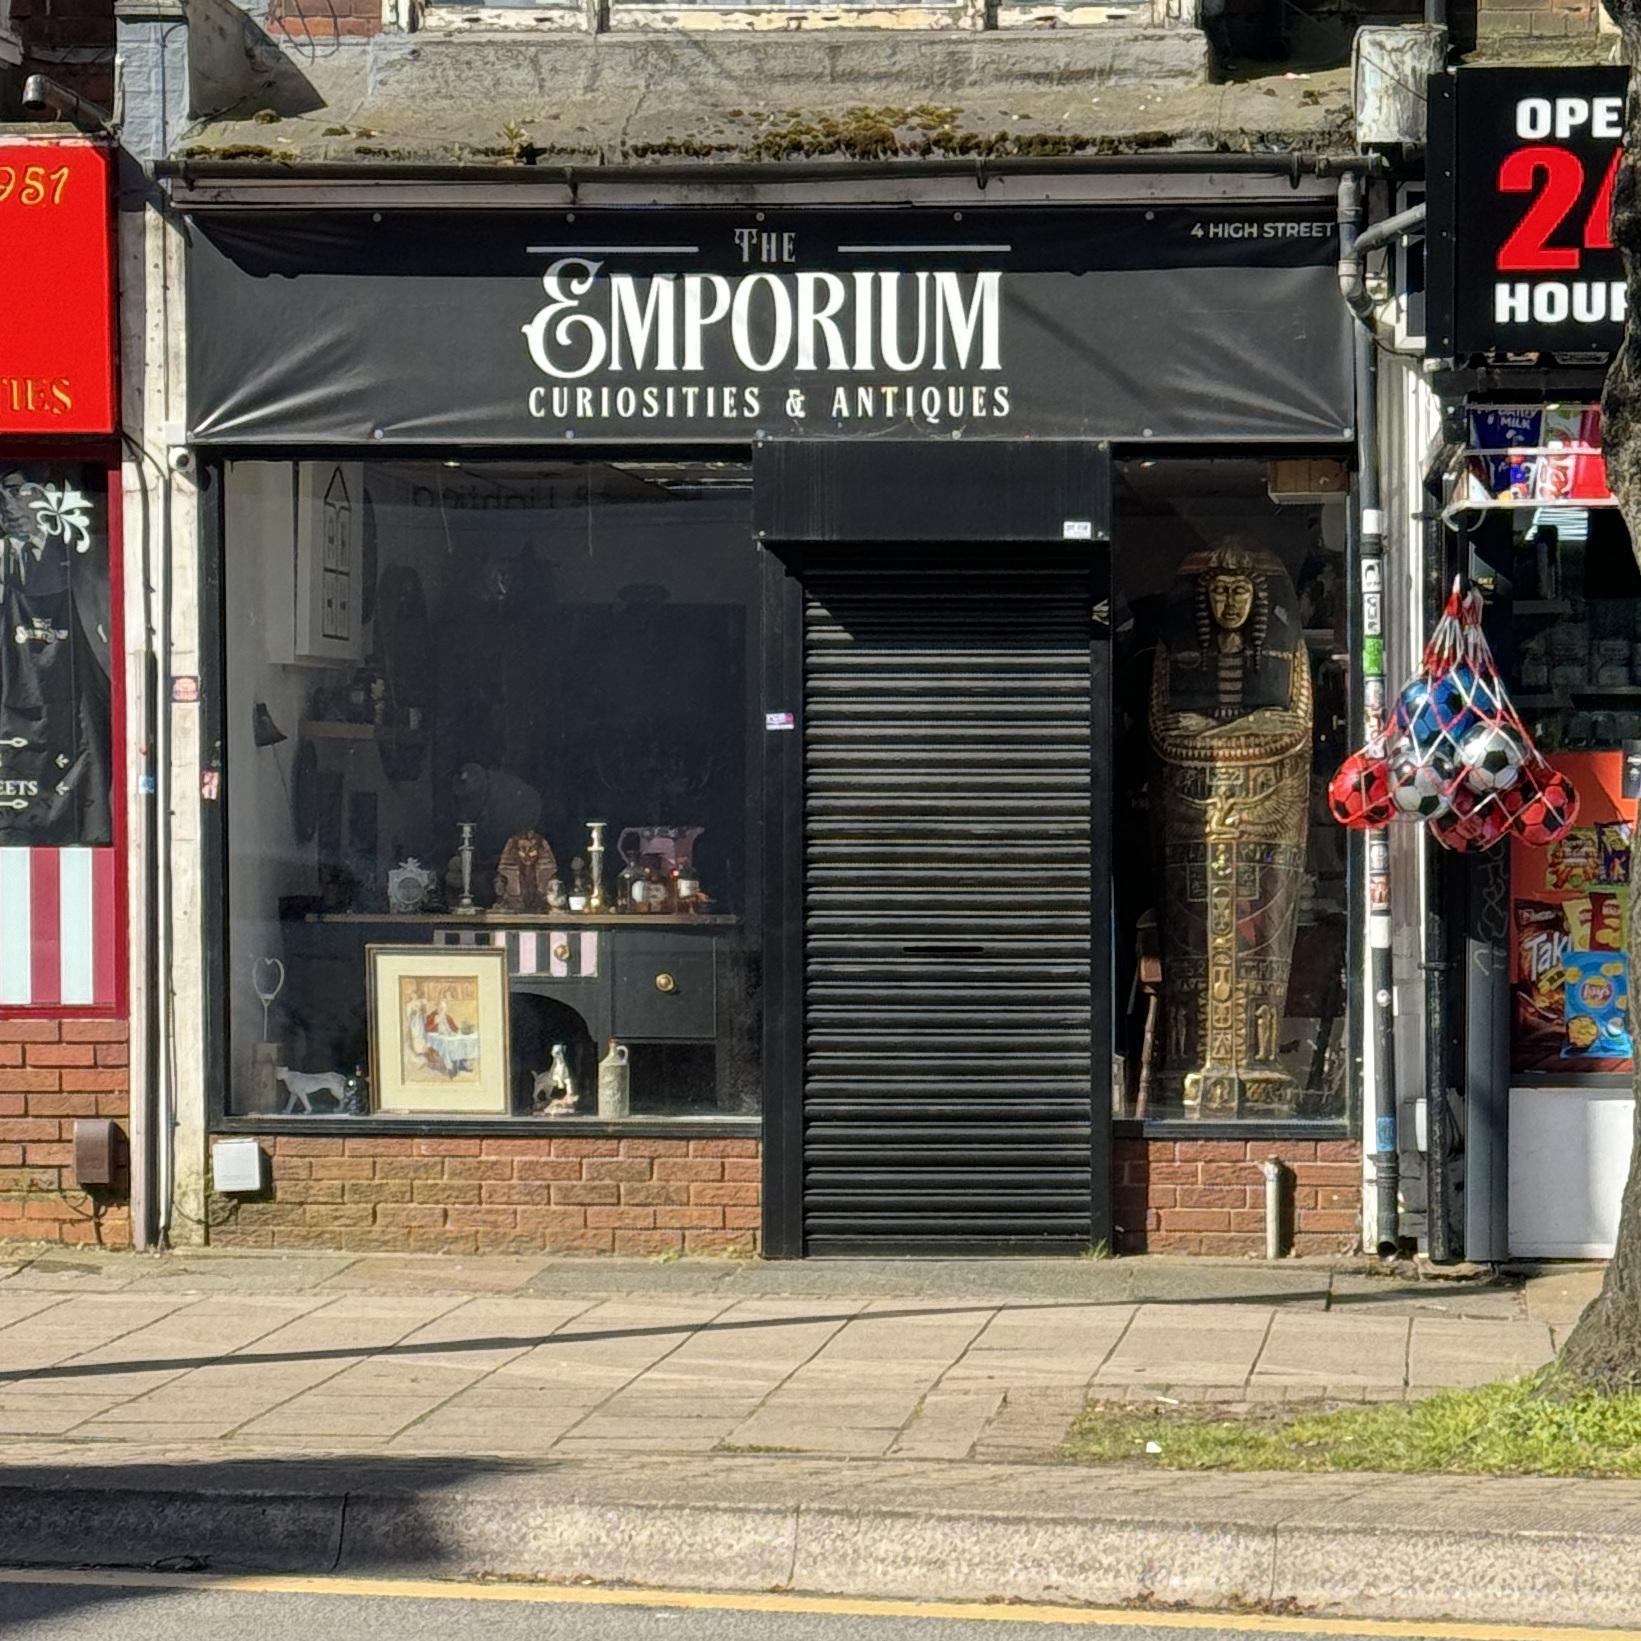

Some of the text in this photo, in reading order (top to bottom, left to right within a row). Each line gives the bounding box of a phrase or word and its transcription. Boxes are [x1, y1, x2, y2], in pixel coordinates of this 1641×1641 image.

[1515, 97, 1623, 140] OPE
[734, 228, 796, 263] THE
[1190, 221, 1336, 239] 4 HIGH STREET
[520, 257, 1003, 379] EMPORIUM
[0, 378, 72, 415] IES
[527, 385, 1011, 424] CURIOSITIES & ANTIQUES
[1500, 416, 1533, 430] MILK
[1523, 930, 1572, 982] Tak
